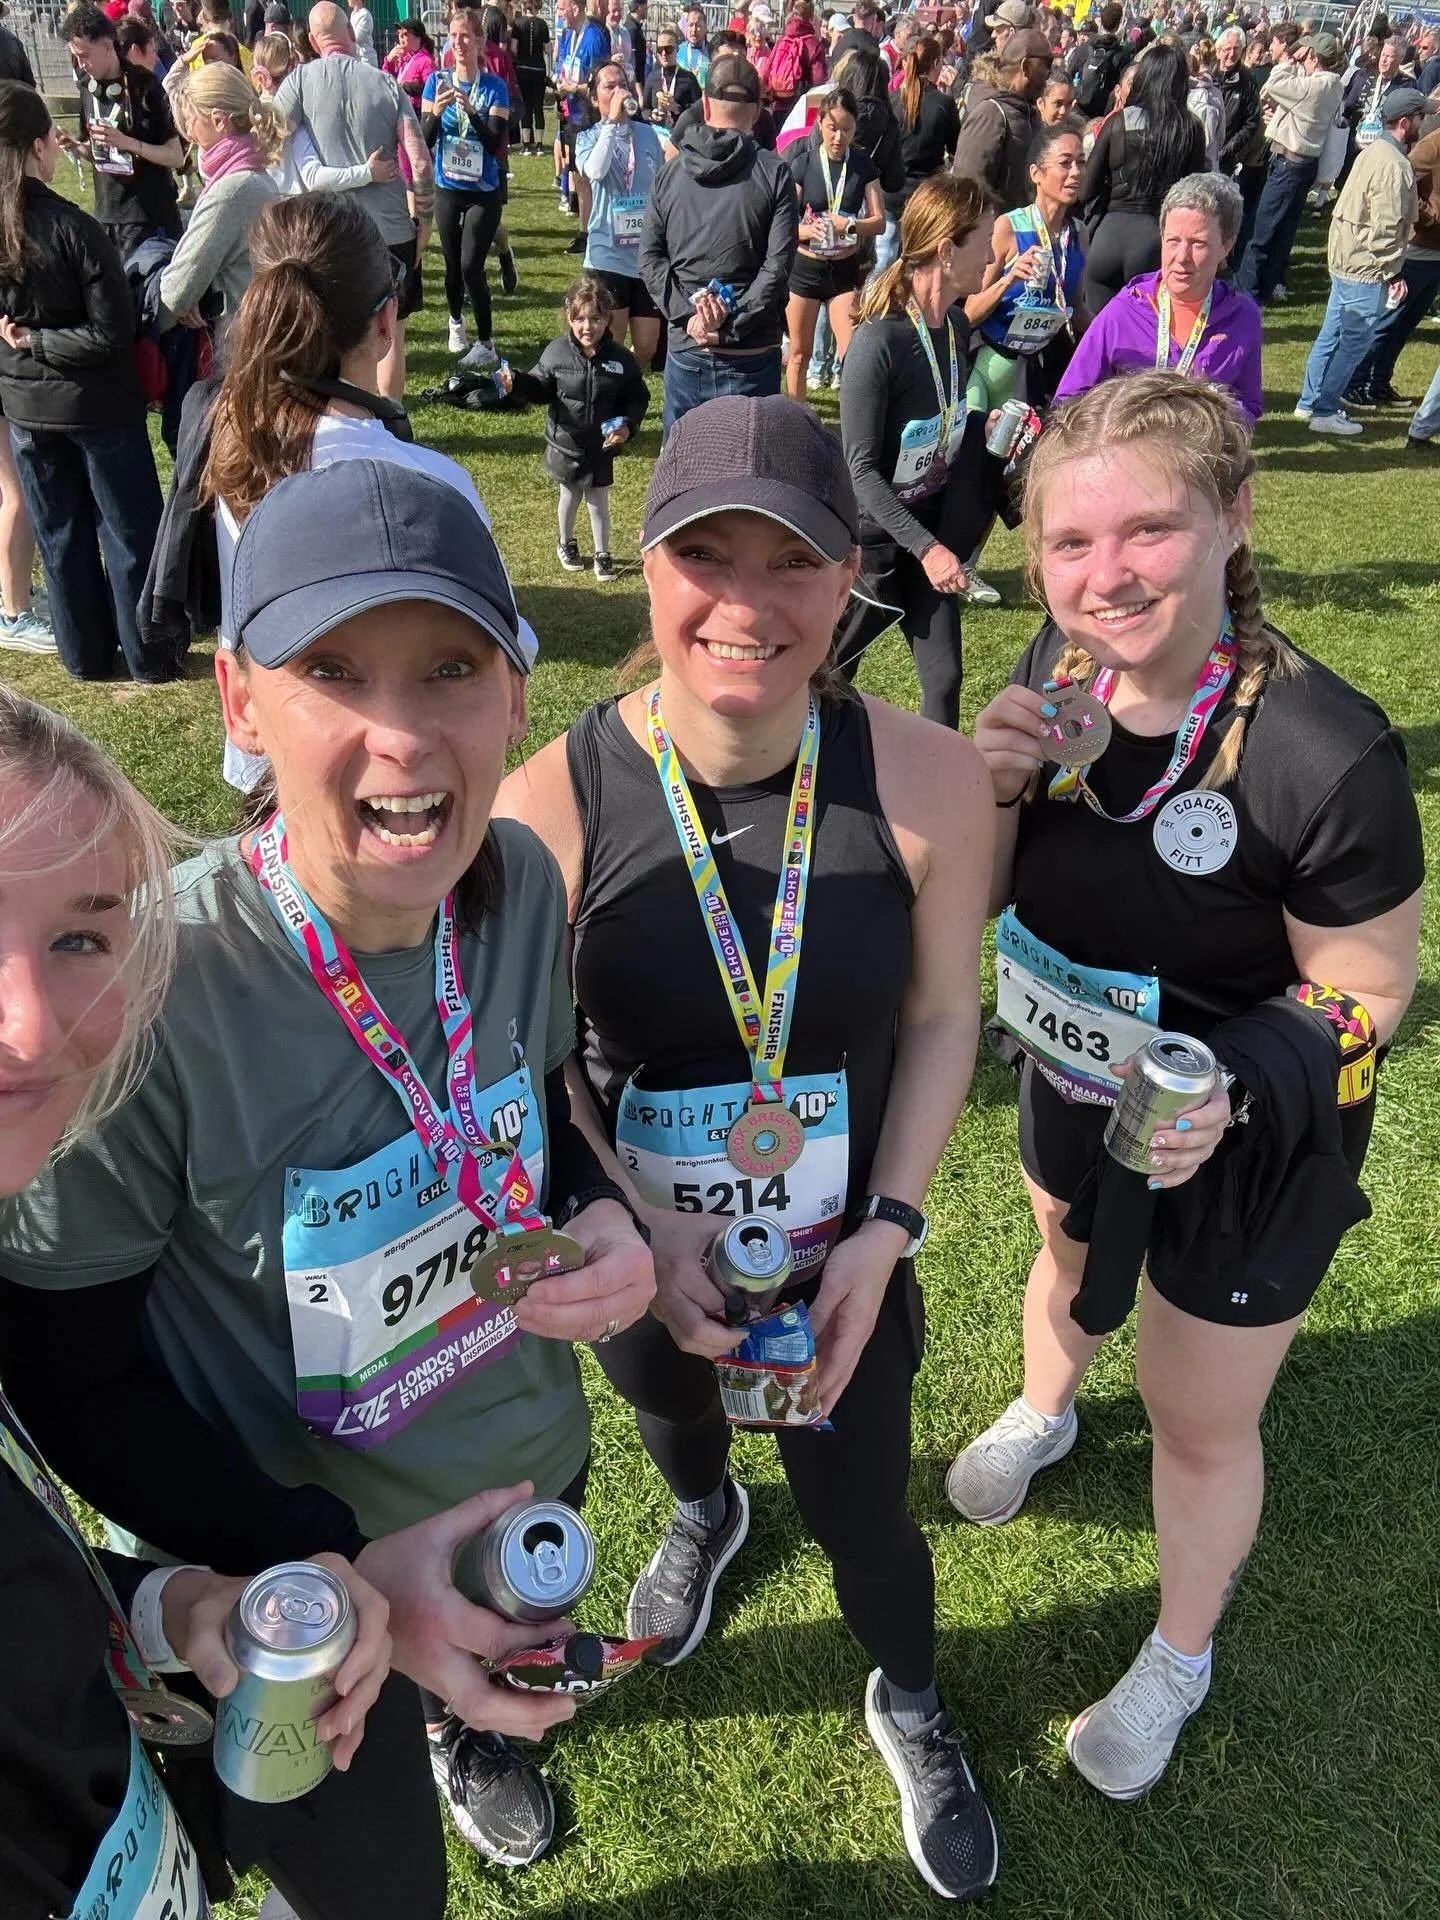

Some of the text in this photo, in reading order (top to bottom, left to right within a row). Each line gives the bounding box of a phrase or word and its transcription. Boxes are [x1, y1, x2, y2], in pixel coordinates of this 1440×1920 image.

[451, 156, 472, 168] 8138
[1168, 715, 1200, 781] FINISHER
[671, 783, 704, 860] FINISHER
[1173, 797, 1232, 830] COACHED
[1160, 820, 1230, 847] EST. 25
[1170, 849, 1203, 867] FITT
[258, 831, 305, 927] FINISHER
[443, 920, 463, 1012] FINISHER
[1002, 967, 1011, 980] 4
[764, 992, 784, 1060] FINISHER
[1024, 993, 1110, 1062] 7463
[623, 1102, 737, 1128] BRIGHT
[627, 1155, 640, 1171] 2
[301, 1154, 420, 1228] BRIGH
[673, 1173, 791, 1217] 5214
[792, 1239, 828, 1260] THON
[304, 1273, 327, 1281] WAVE
[308, 1284, 329, 1303] 2
[382, 1223, 490, 1327] 9718
[359, 1357, 389, 1384] MEDAL
[398, 1340, 460, 1394] LONDON
[400, 1332, 503, 1410] EVENTS INSPIRING
